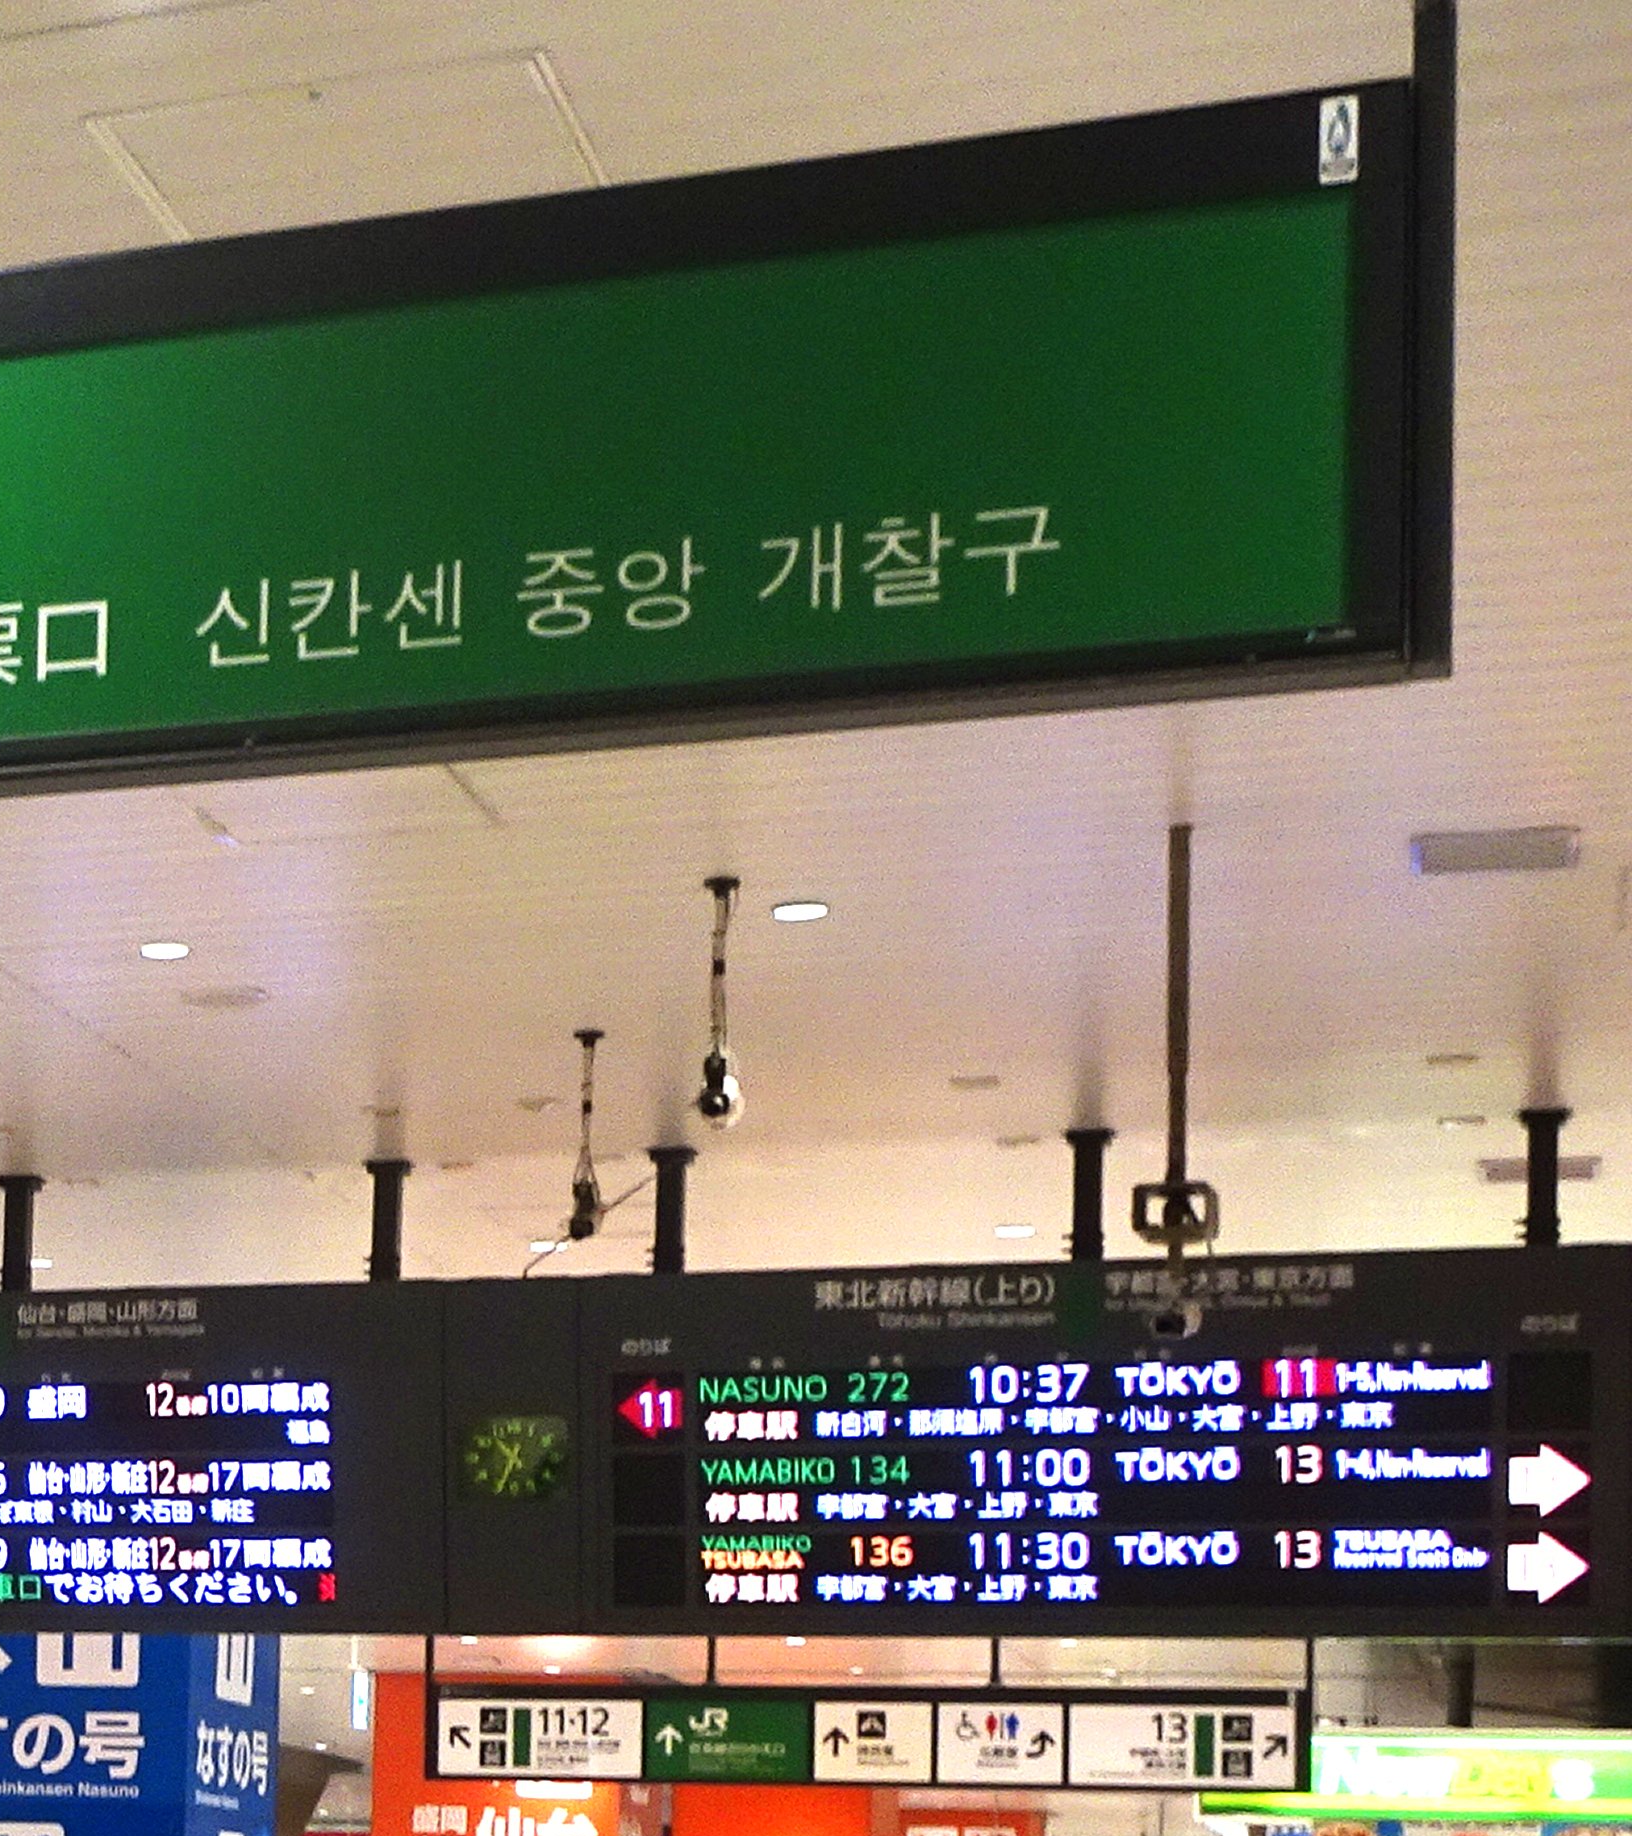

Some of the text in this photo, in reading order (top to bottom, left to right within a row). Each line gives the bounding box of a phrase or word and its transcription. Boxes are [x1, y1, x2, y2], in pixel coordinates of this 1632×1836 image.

[195, 504, 1063, 671] 신칸센 중앙 개찰구
[699, 1373, 827, 1402] NASUNO
[847, 1372, 911, 1402] 272
[969, 1361, 1090, 1403] 10:37
[1273, 1358, 1317, 1398] 11
[28, 1385, 87, 1419] 盛岡
[637, 1390, 672, 1429] 11
[705, 1410, 799, 1441] 停車駅
[700, 1456, 835, 1485] YAMABIKO
[851, 1455, 911, 1485] 134
[969, 1448, 1090, 1487] 11:00
[1274, 1445, 1323, 1484] 13
[705, 1492, 799, 1523] 停車駅
[701, 1551, 806, 1571] TSUBASA
[702, 1534, 812, 1552] YAMABIKO
[851, 1535, 914, 1567] 136
[969, 1532, 1090, 1571] 11:30
[1274, 1530, 1322, 1570] 13
[705, 1573, 799, 1604] 停車駅
[688, 1707, 729, 1731] JR
[1152, 1711, 1188, 1743] 13
[195, 1718, 269, 1797] なすの号
[78, 1780, 140, 1799] Nasuno
[412, 1803, 467, 1834] 盛岡
